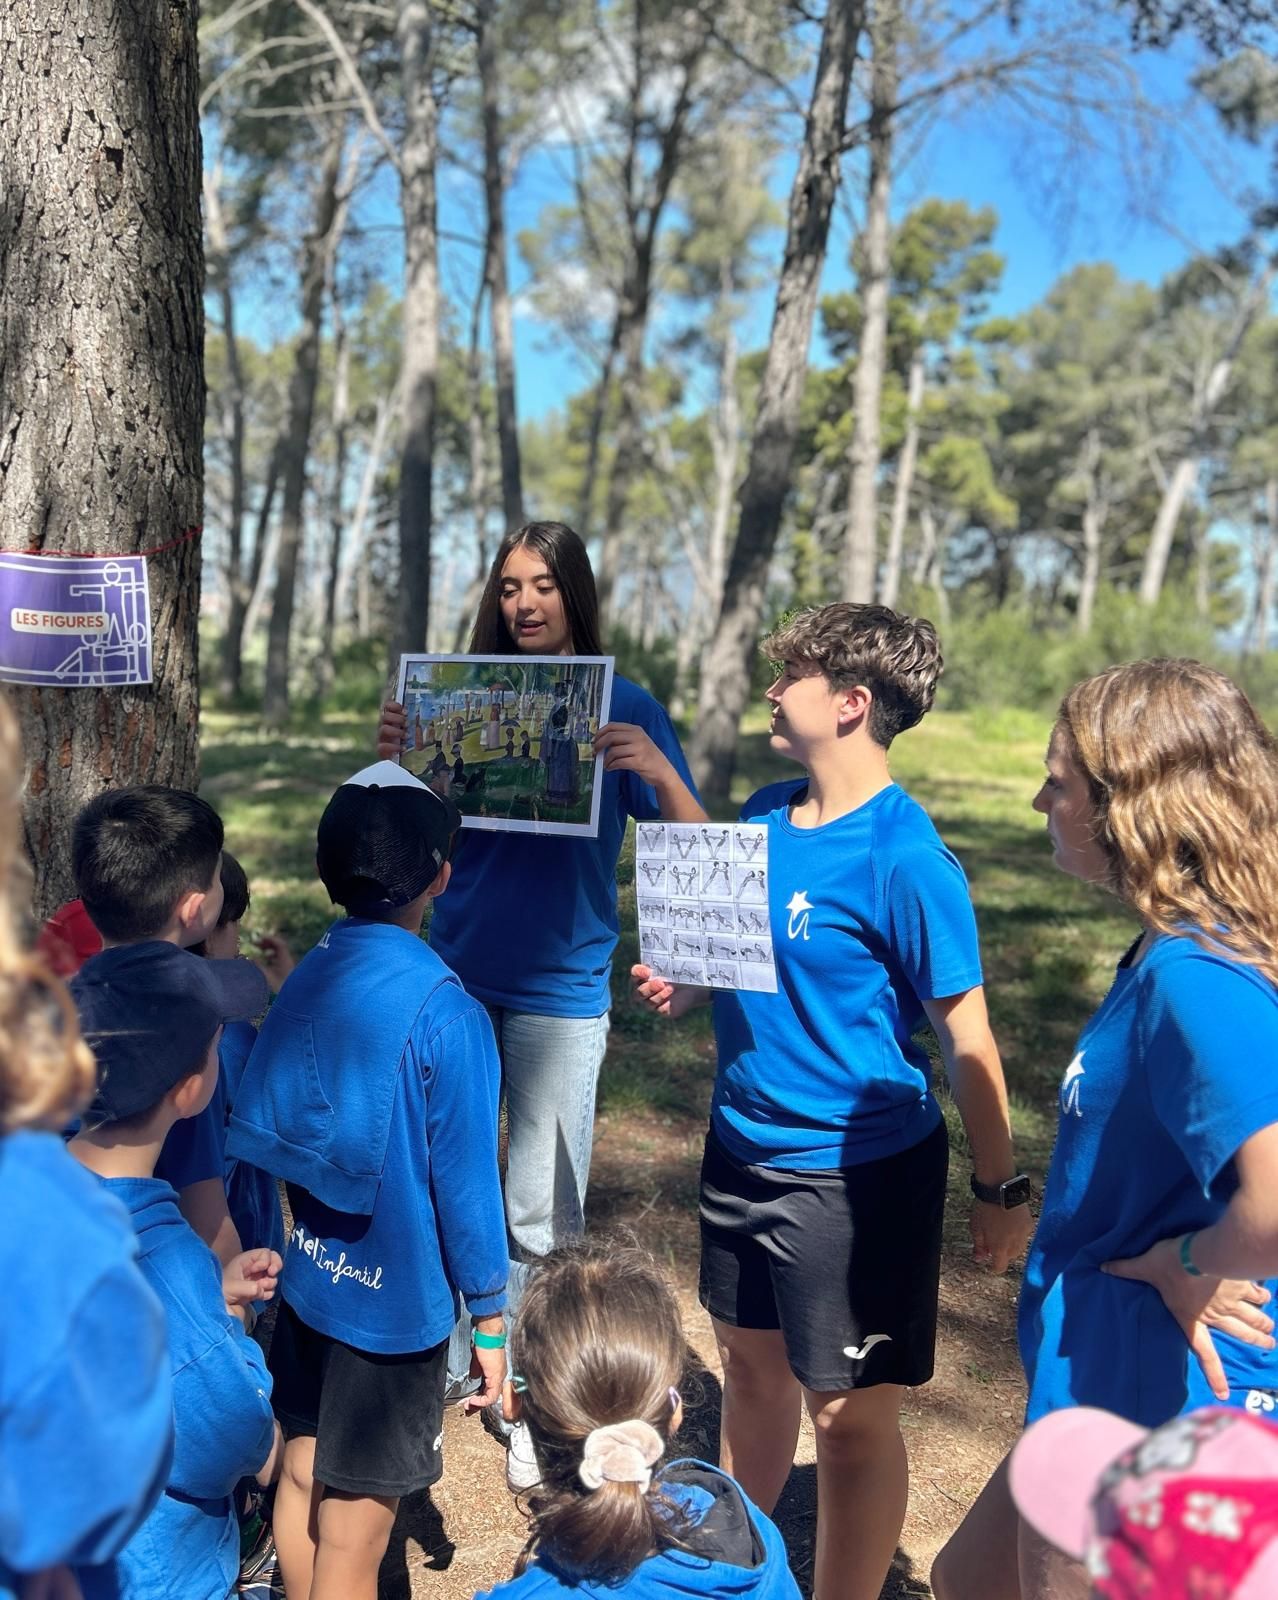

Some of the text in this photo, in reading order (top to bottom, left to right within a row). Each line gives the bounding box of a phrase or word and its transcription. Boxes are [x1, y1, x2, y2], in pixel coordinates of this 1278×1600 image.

[16, 612, 104, 628] LES FIGURES
[316, 1244, 382, 1289] Infantil
